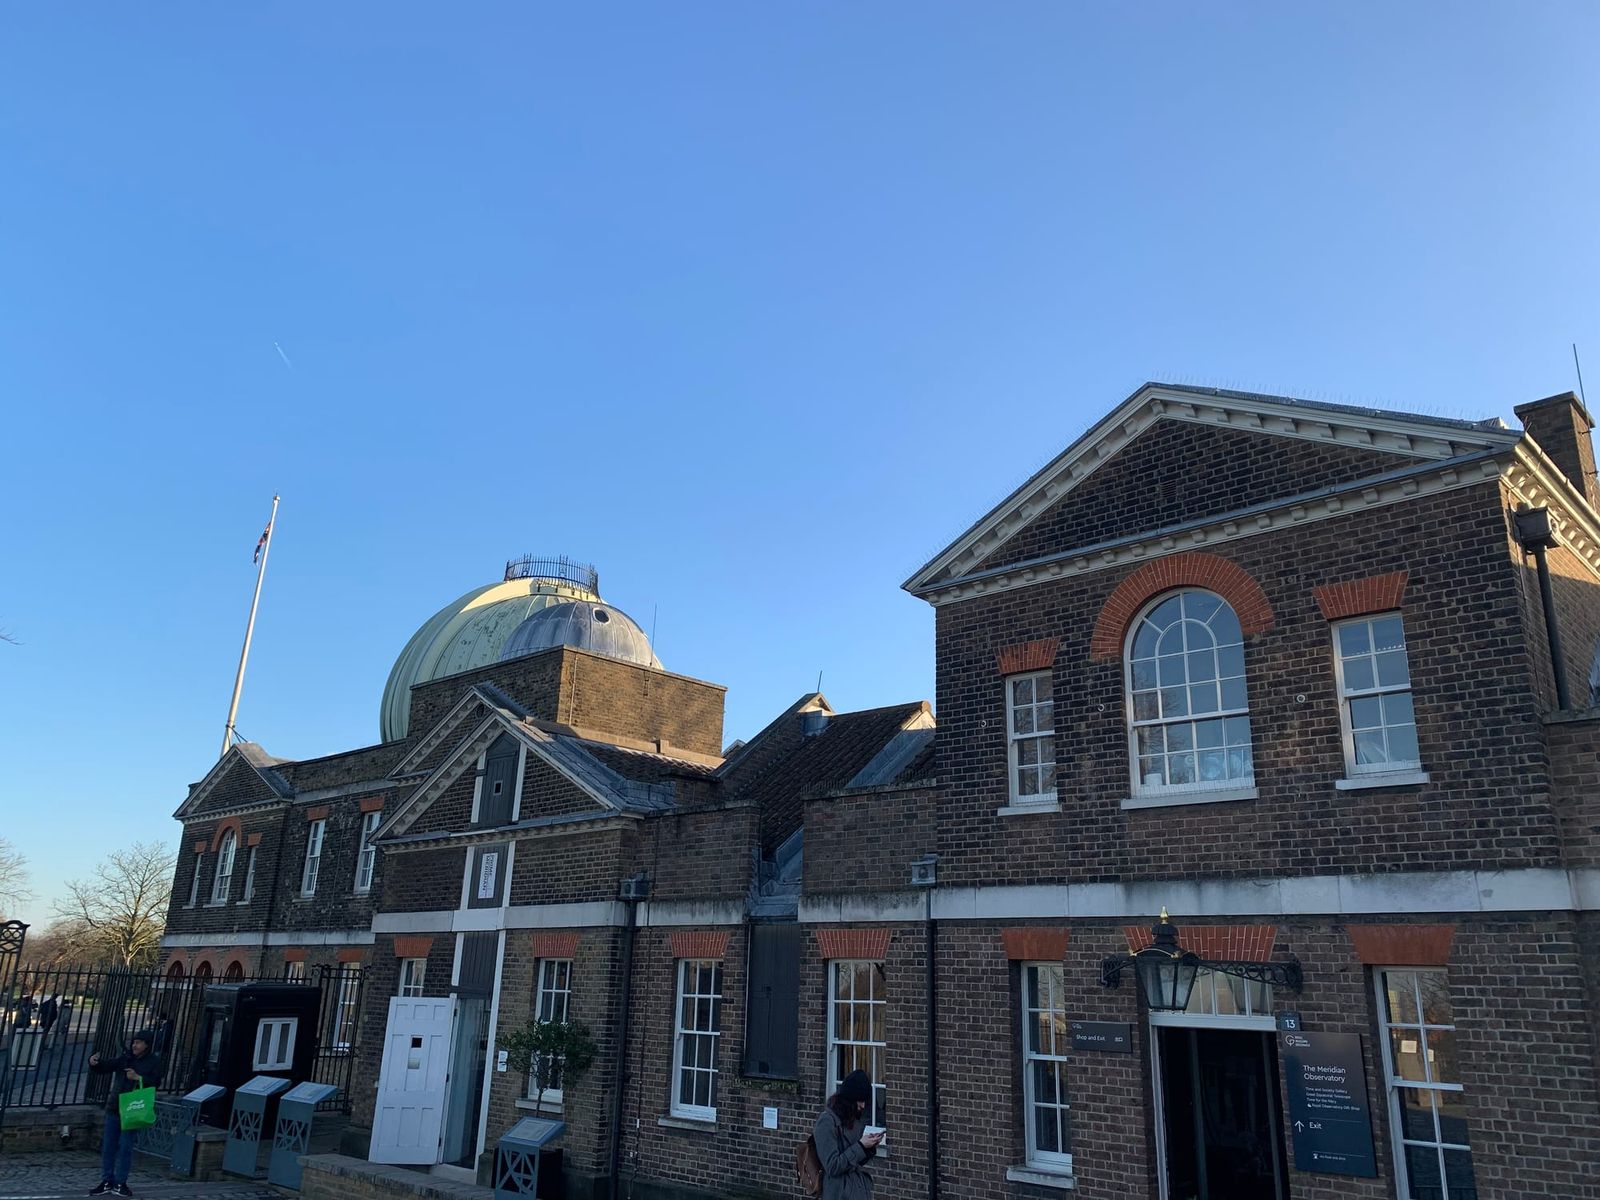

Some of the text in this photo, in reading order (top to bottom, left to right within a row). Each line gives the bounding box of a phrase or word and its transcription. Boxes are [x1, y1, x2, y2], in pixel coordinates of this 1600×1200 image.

[1285, 1019, 1296, 1029] 13
[1303, 1064, 1346, 1074] The Meridian
[1303, 1072, 1346, 1083] Observatory
[1309, 1121, 1322, 1130] Exit
